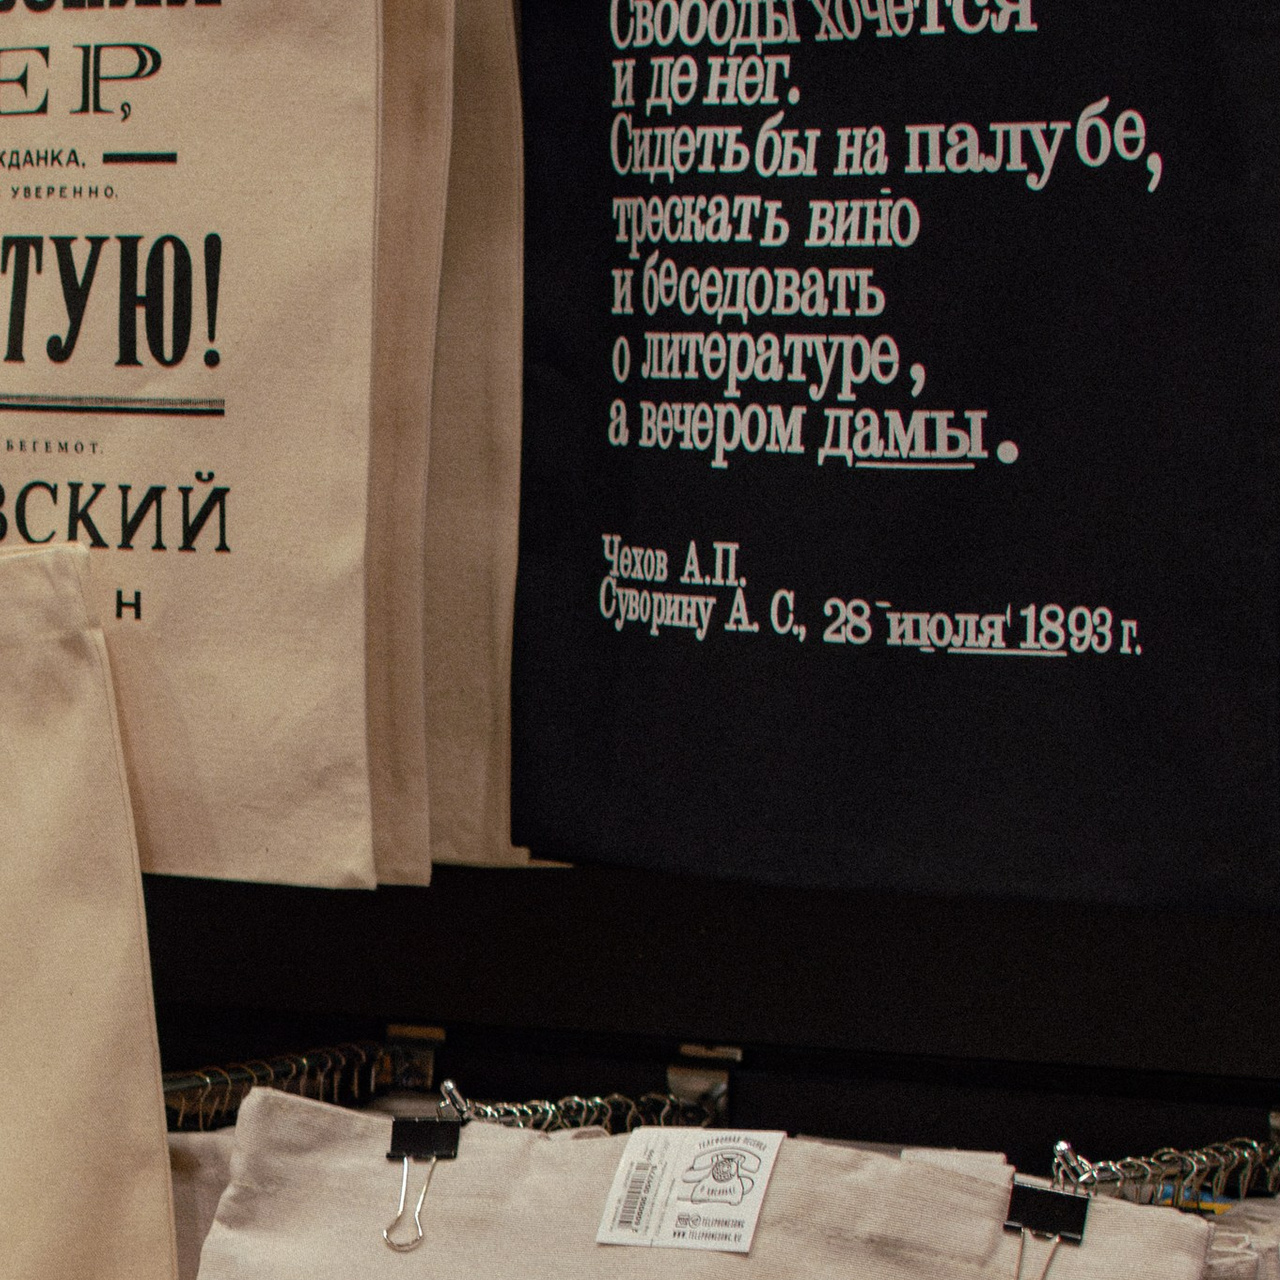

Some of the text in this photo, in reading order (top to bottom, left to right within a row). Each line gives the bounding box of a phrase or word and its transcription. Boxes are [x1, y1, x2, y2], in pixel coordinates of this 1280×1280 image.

[612, 59, 636, 107] и
[610, 97, 1162, 192] Сидеть бы на палубе,
[613, 190, 920, 258] трескать вино
[611, 250, 886, 324] и беседовать
[612, 332, 926, 402] о литературе,
[608, 398, 1019, 470] а вечером дамы.
[602, 534, 747, 587] Чехов А.П.
[599, 577, 717, 640] Суворину
[724, 588, 760, 633] А.
[823, 598, 872, 645] 28
[885, 606, 1010, 650] июля
[1021, 604, 1113, 653] 1893
[1120, 620, 1142, 655] г.
